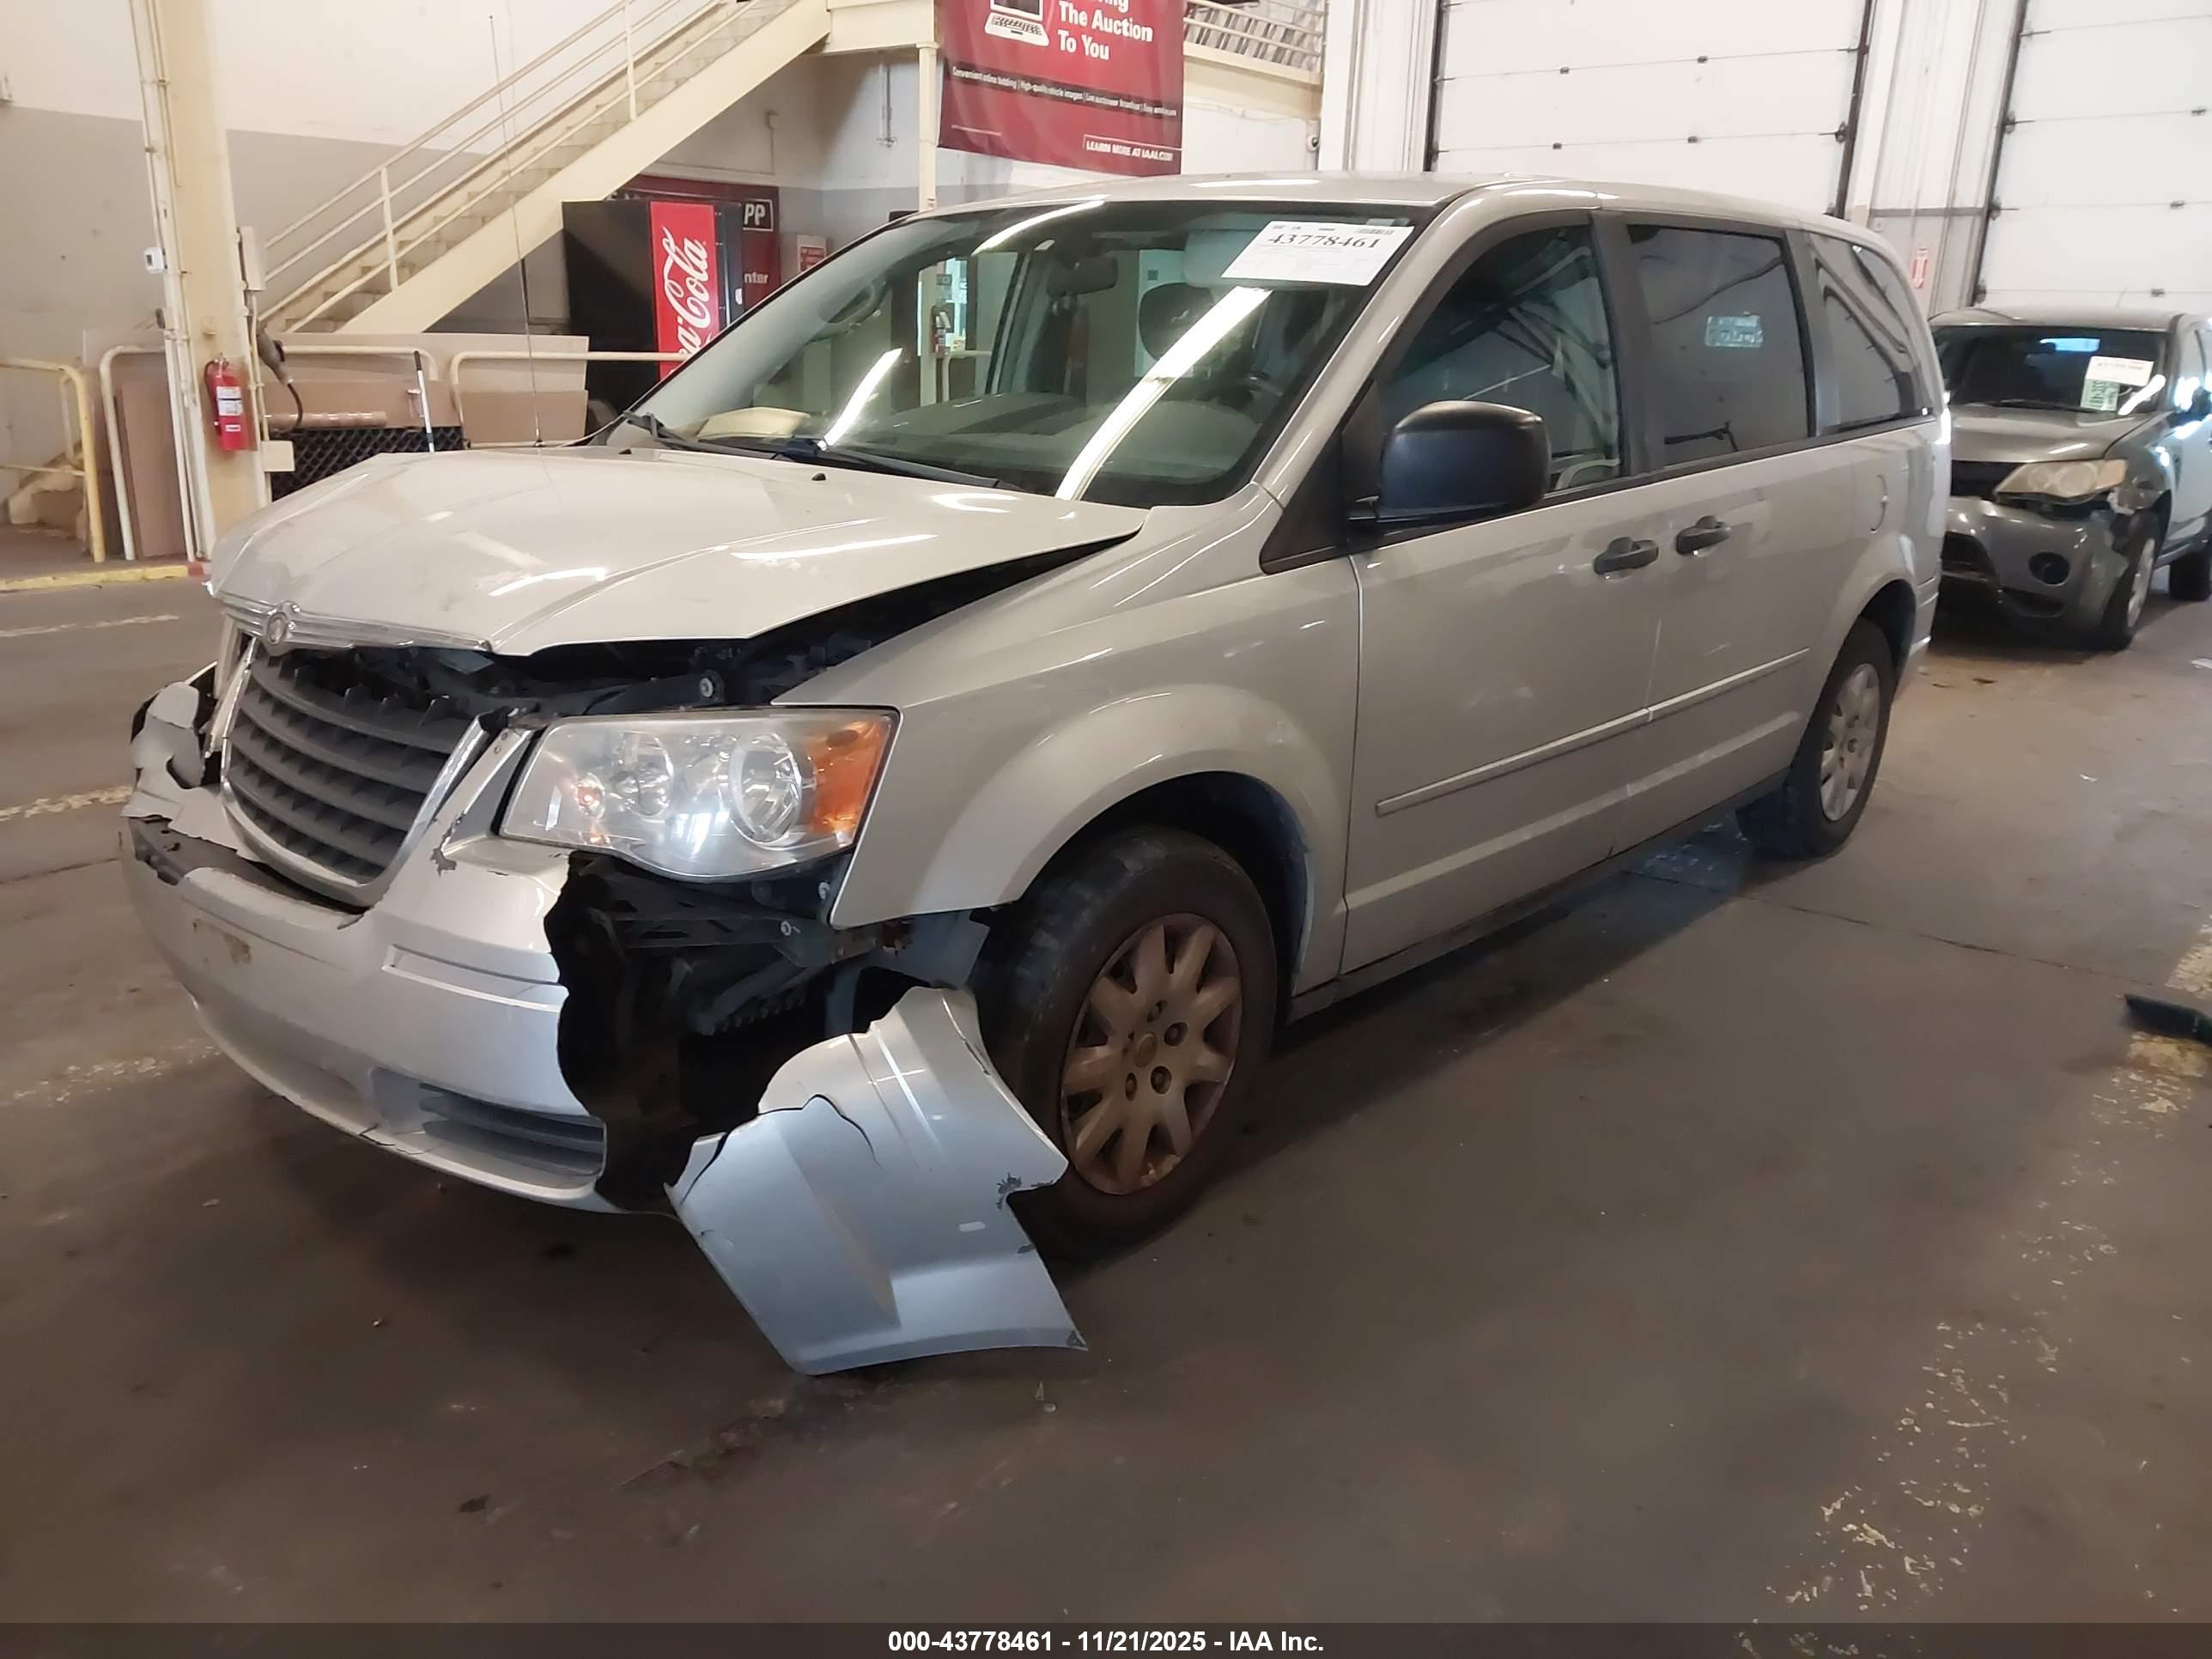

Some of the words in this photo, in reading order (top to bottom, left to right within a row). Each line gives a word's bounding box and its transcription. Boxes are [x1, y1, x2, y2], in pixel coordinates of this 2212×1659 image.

[1058, 1, 1088, 27] The
[1091, 9, 1153, 41] Auction
[1057, 29, 1077, 53] To
[1081, 34, 1109, 60] You
[1086, 140, 1110, 153] LEARN
[1112, 143, 1130, 155] MORE
[1132, 148, 1141, 158] AT
[1268, 234, 1381, 248] 43778461
